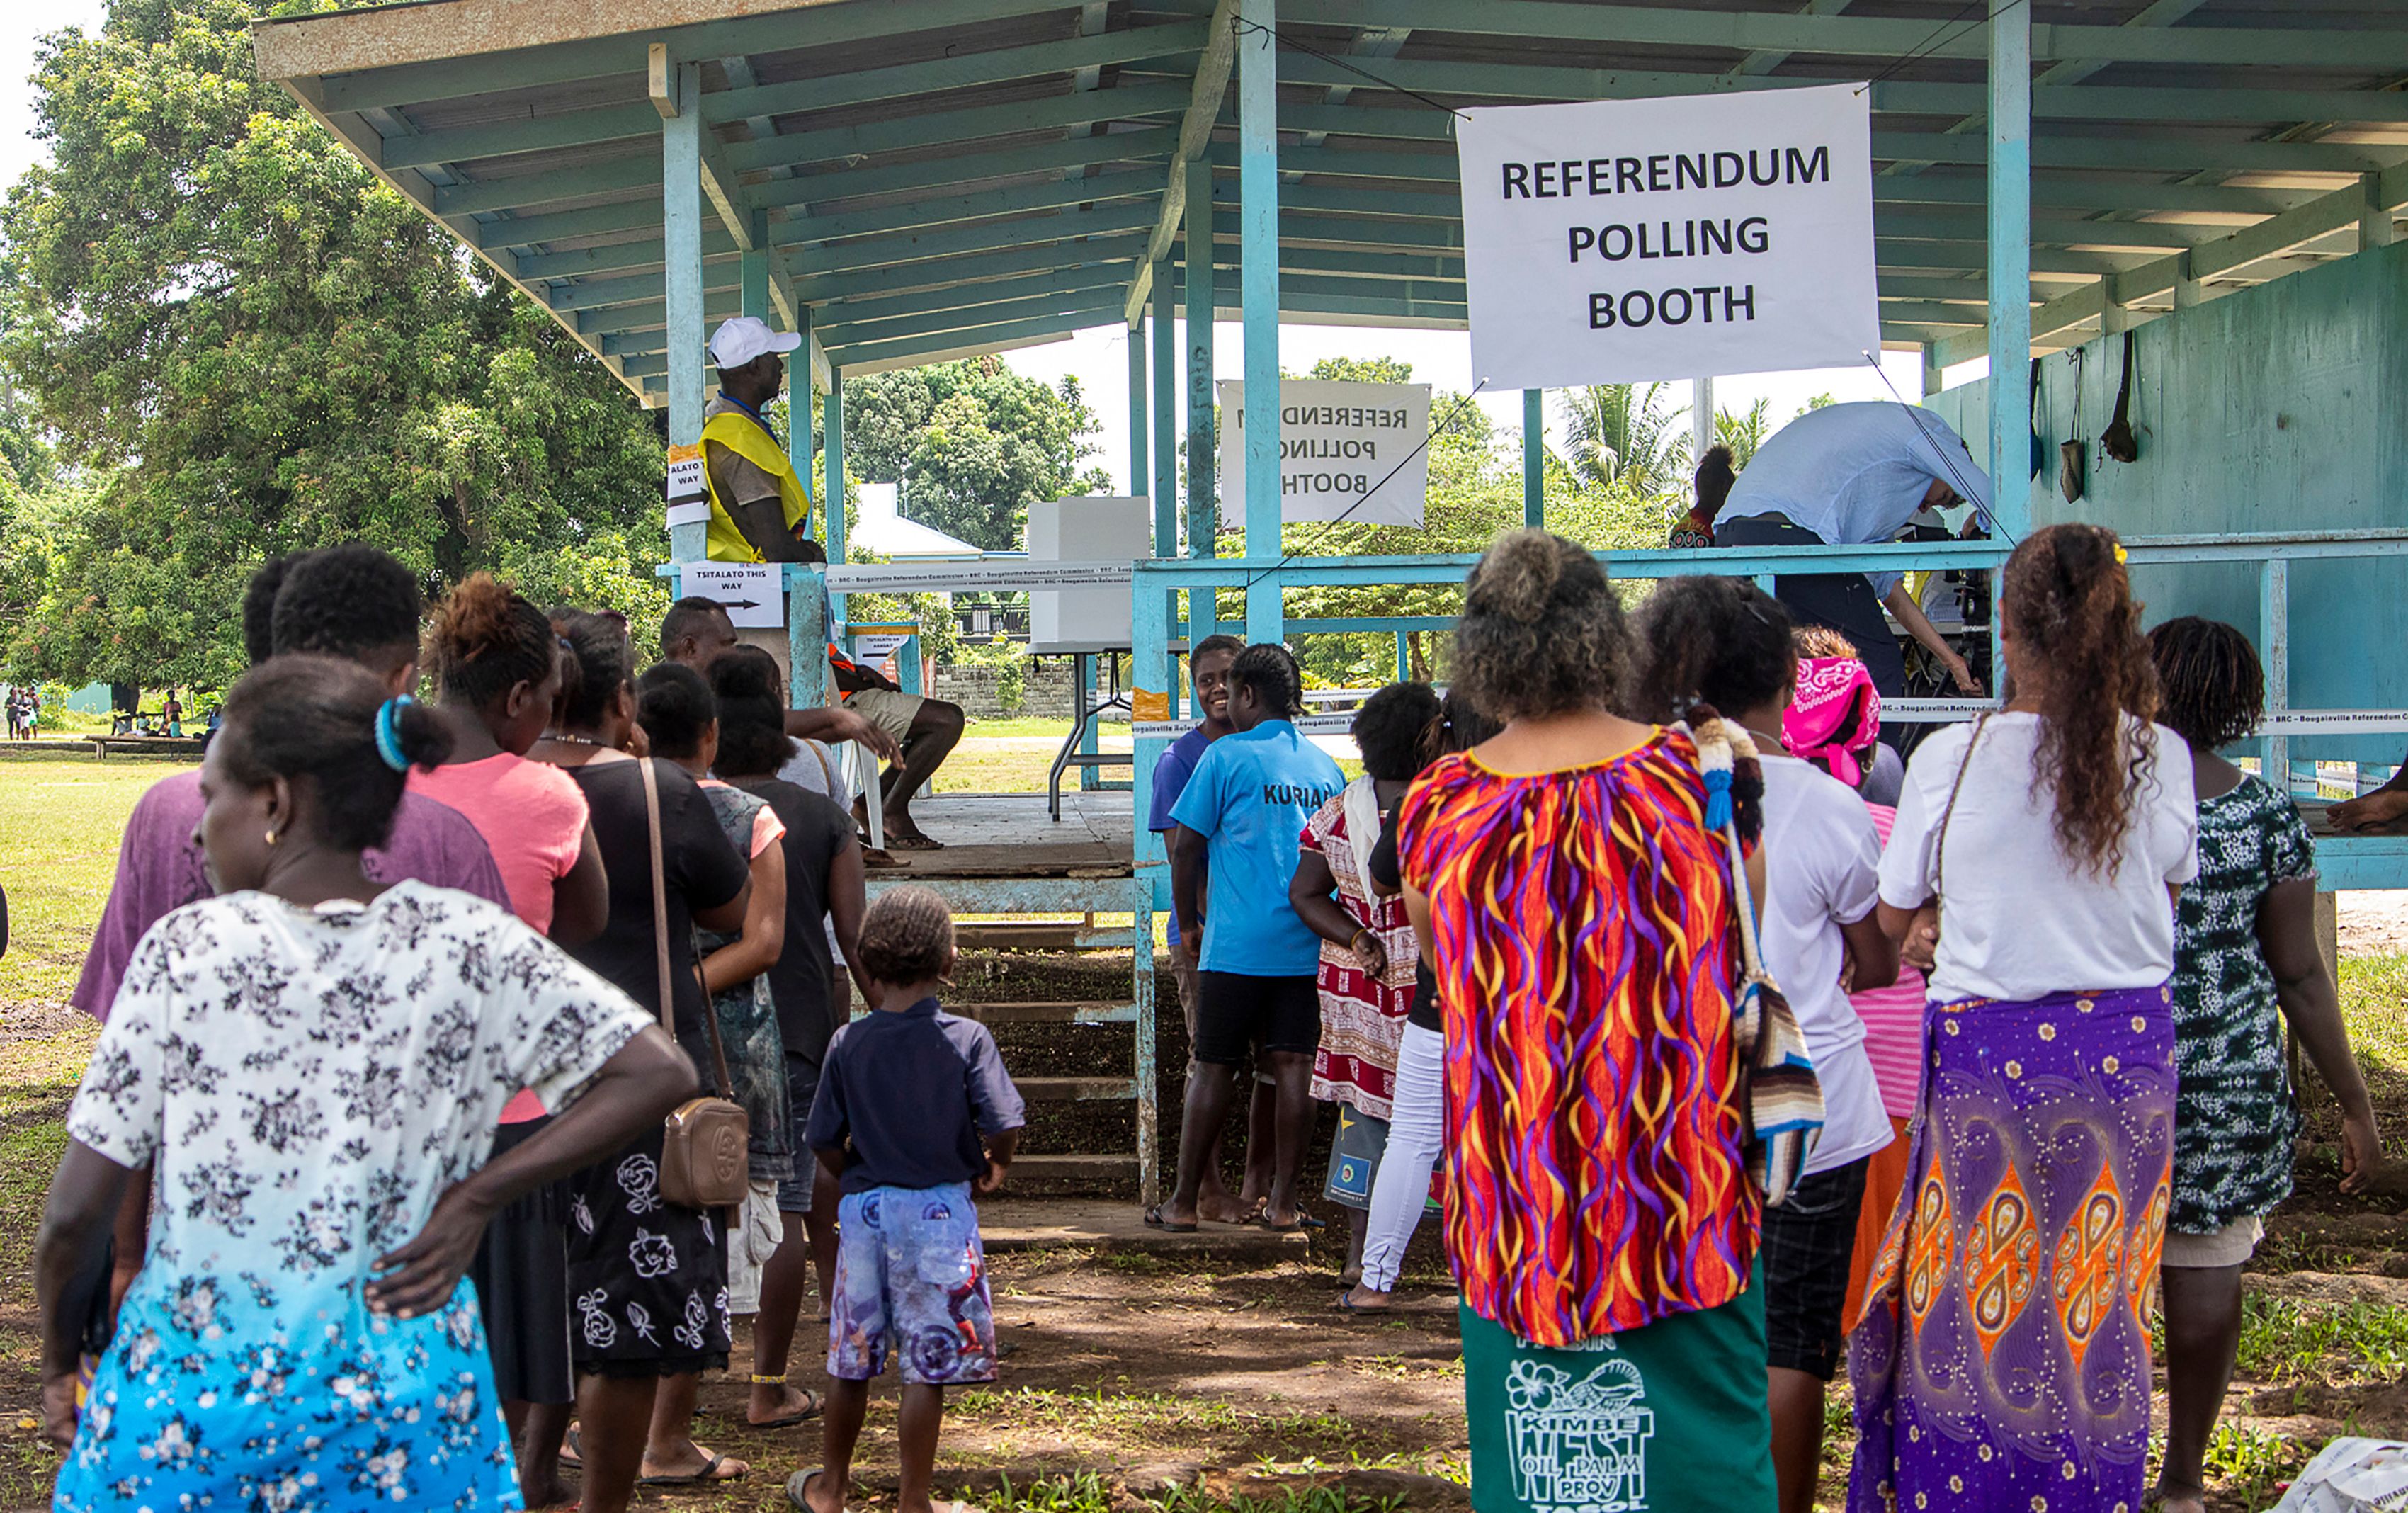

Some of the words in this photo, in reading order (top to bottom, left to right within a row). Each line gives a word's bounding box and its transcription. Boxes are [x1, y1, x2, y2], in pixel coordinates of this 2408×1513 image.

[1502, 146, 1830, 199] REFERENDUM
[1569, 217, 1769, 263] POLLING
[1589, 285, 1755, 329] BOOTH
[671, 463, 699, 473] ALATO
[678, 475, 698, 484] WAY
[2300, 715, 2350, 723] Bougainville
[1522, 1416, 1638, 1432] KIMBE
[1521, 1456, 1562, 1475] OIL
[1574, 1456, 1640, 1475] PALM
[1560, 1480, 1616, 1497] PROV
